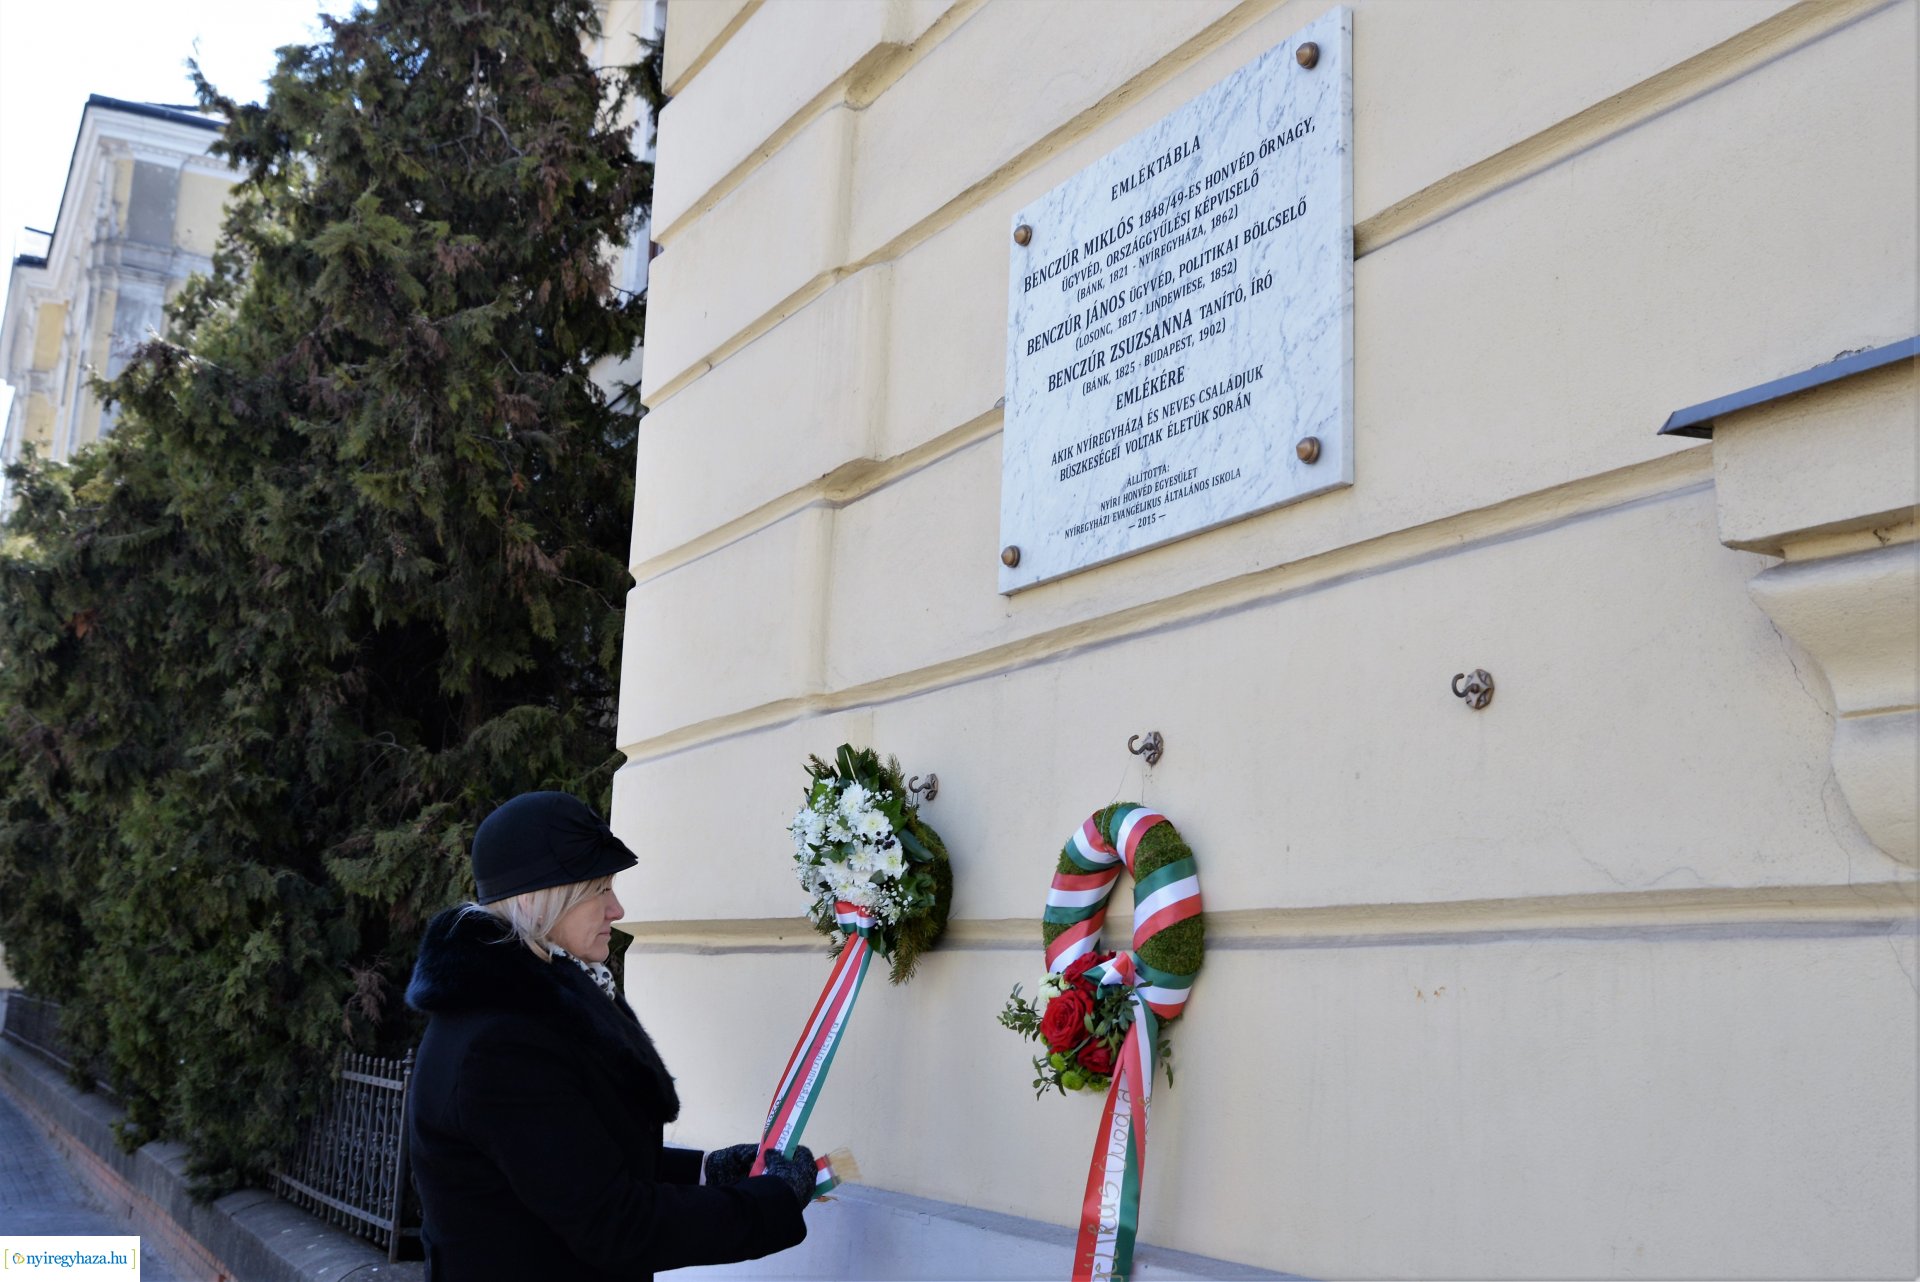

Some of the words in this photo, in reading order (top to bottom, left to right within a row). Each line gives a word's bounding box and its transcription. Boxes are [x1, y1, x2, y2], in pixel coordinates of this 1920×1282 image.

[1024, 248, 1079, 293] BENCZÚR
[1083, 216, 1134, 259] MIKLÓS
[1138, 181, 1201, 229] 1848/49-ES
[1204, 151, 1255, 190] HONVÉD
[1259, 116, 1315, 159] ŐRNAGY,
[1111, 134, 1201, 202] EMLÉKTÁBLA
[1026, 314, 1082, 357] BENCZÚR
[1085, 290, 1126, 330] JÁNOS
[1129, 270, 1175, 303] ÜGYVÉD,
[1179, 234, 1239, 278] POLITIKAI
[1243, 195, 1307, 245] BÖLCSELŐ
[1061, 261, 1103, 292] ÜGYVÉD,
[1194, 168, 1260, 220] KÉPVISELŐ
[1077, 277, 1106, 303] (BÁNK,
[1109, 265, 1129, 284] 1821
[1138, 223, 1207, 269] NYÍREGYHÁZA,
[1211, 203, 1239, 231] 1862)
[1048, 350, 1106, 393] BENCZÚR
[1110, 308, 1193, 363] ZSUZSANNA
[1200, 283, 1247, 320] TANÍTÓ,
[1251, 269, 1273, 296] ÍRÓ
[1075, 322, 1113, 351] (LOSONC,
[1117, 309, 1137, 329] 1817
[1145, 276, 1205, 315] LINDEWIESE,
[1210, 257, 1237, 283] 1852)
[1082, 372, 1111, 396] (BÁNK,
[1115, 361, 1135, 380] 1825
[1144, 334, 1195, 367] BUDAPEST,
[1200, 317, 1226, 342] 1902)
[1116, 365, 1185, 411] EMLÉKÉRE
[1051, 445, 1074, 466] AKIK
[1076, 415, 1143, 455] NYÍREGYHÁZA
[1147, 408, 1159, 426] ÉS
[1162, 393, 1196, 419] NEVES
[1199, 364, 1263, 404] CSALÁDJUK
[1060, 445, 1121, 481] BÜSZKESÉGEI
[1125, 428, 1163, 455] VOLTAK
[1167, 409, 1210, 439] ÉLETÜK
[1212, 391, 1251, 421] SORÁN
[1064, 515, 1110, 539] NYÍREGYHÁZI
[1112, 495, 1162, 522] EVANGÉLIKUS
[1164, 478, 1210, 504] ÁLTALÁNOS
[1211, 467, 1241, 487] ISKOLA
[1100, 495, 1121, 512] NYÍRI
[1123, 483, 1153, 504] HONVÉD
[1154, 467, 1198, 492] EGYESÜLET
[1137, 514, 1156, 529] 2015
